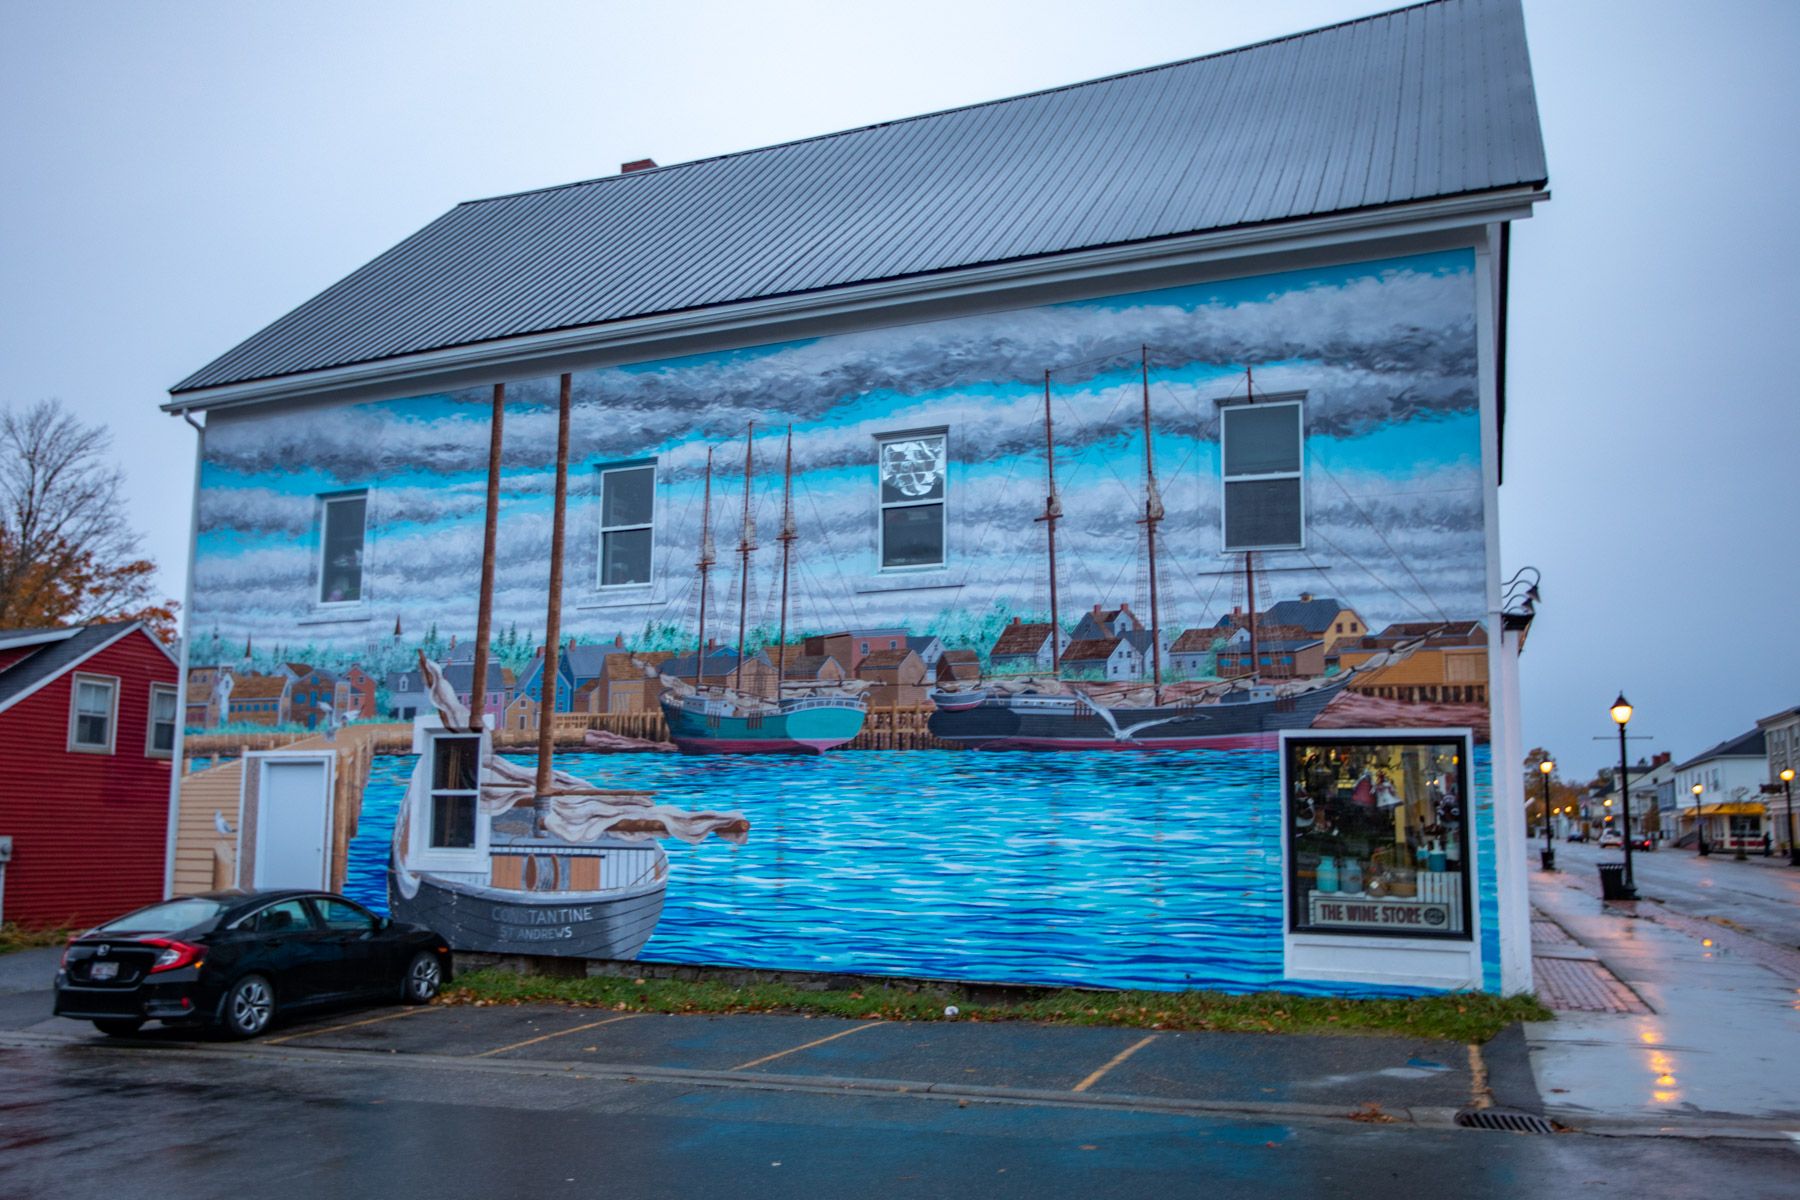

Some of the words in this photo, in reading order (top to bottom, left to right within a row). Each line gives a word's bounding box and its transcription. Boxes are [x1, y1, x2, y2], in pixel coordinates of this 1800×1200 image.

[492, 907, 593, 924] CONSTANTINE
[1320, 904, 1343, 920] THE
[1346, 905, 1378, 922] WINE
[1382, 906, 1421, 923] STORE
[517, 926, 573, 940] ANDREWS
